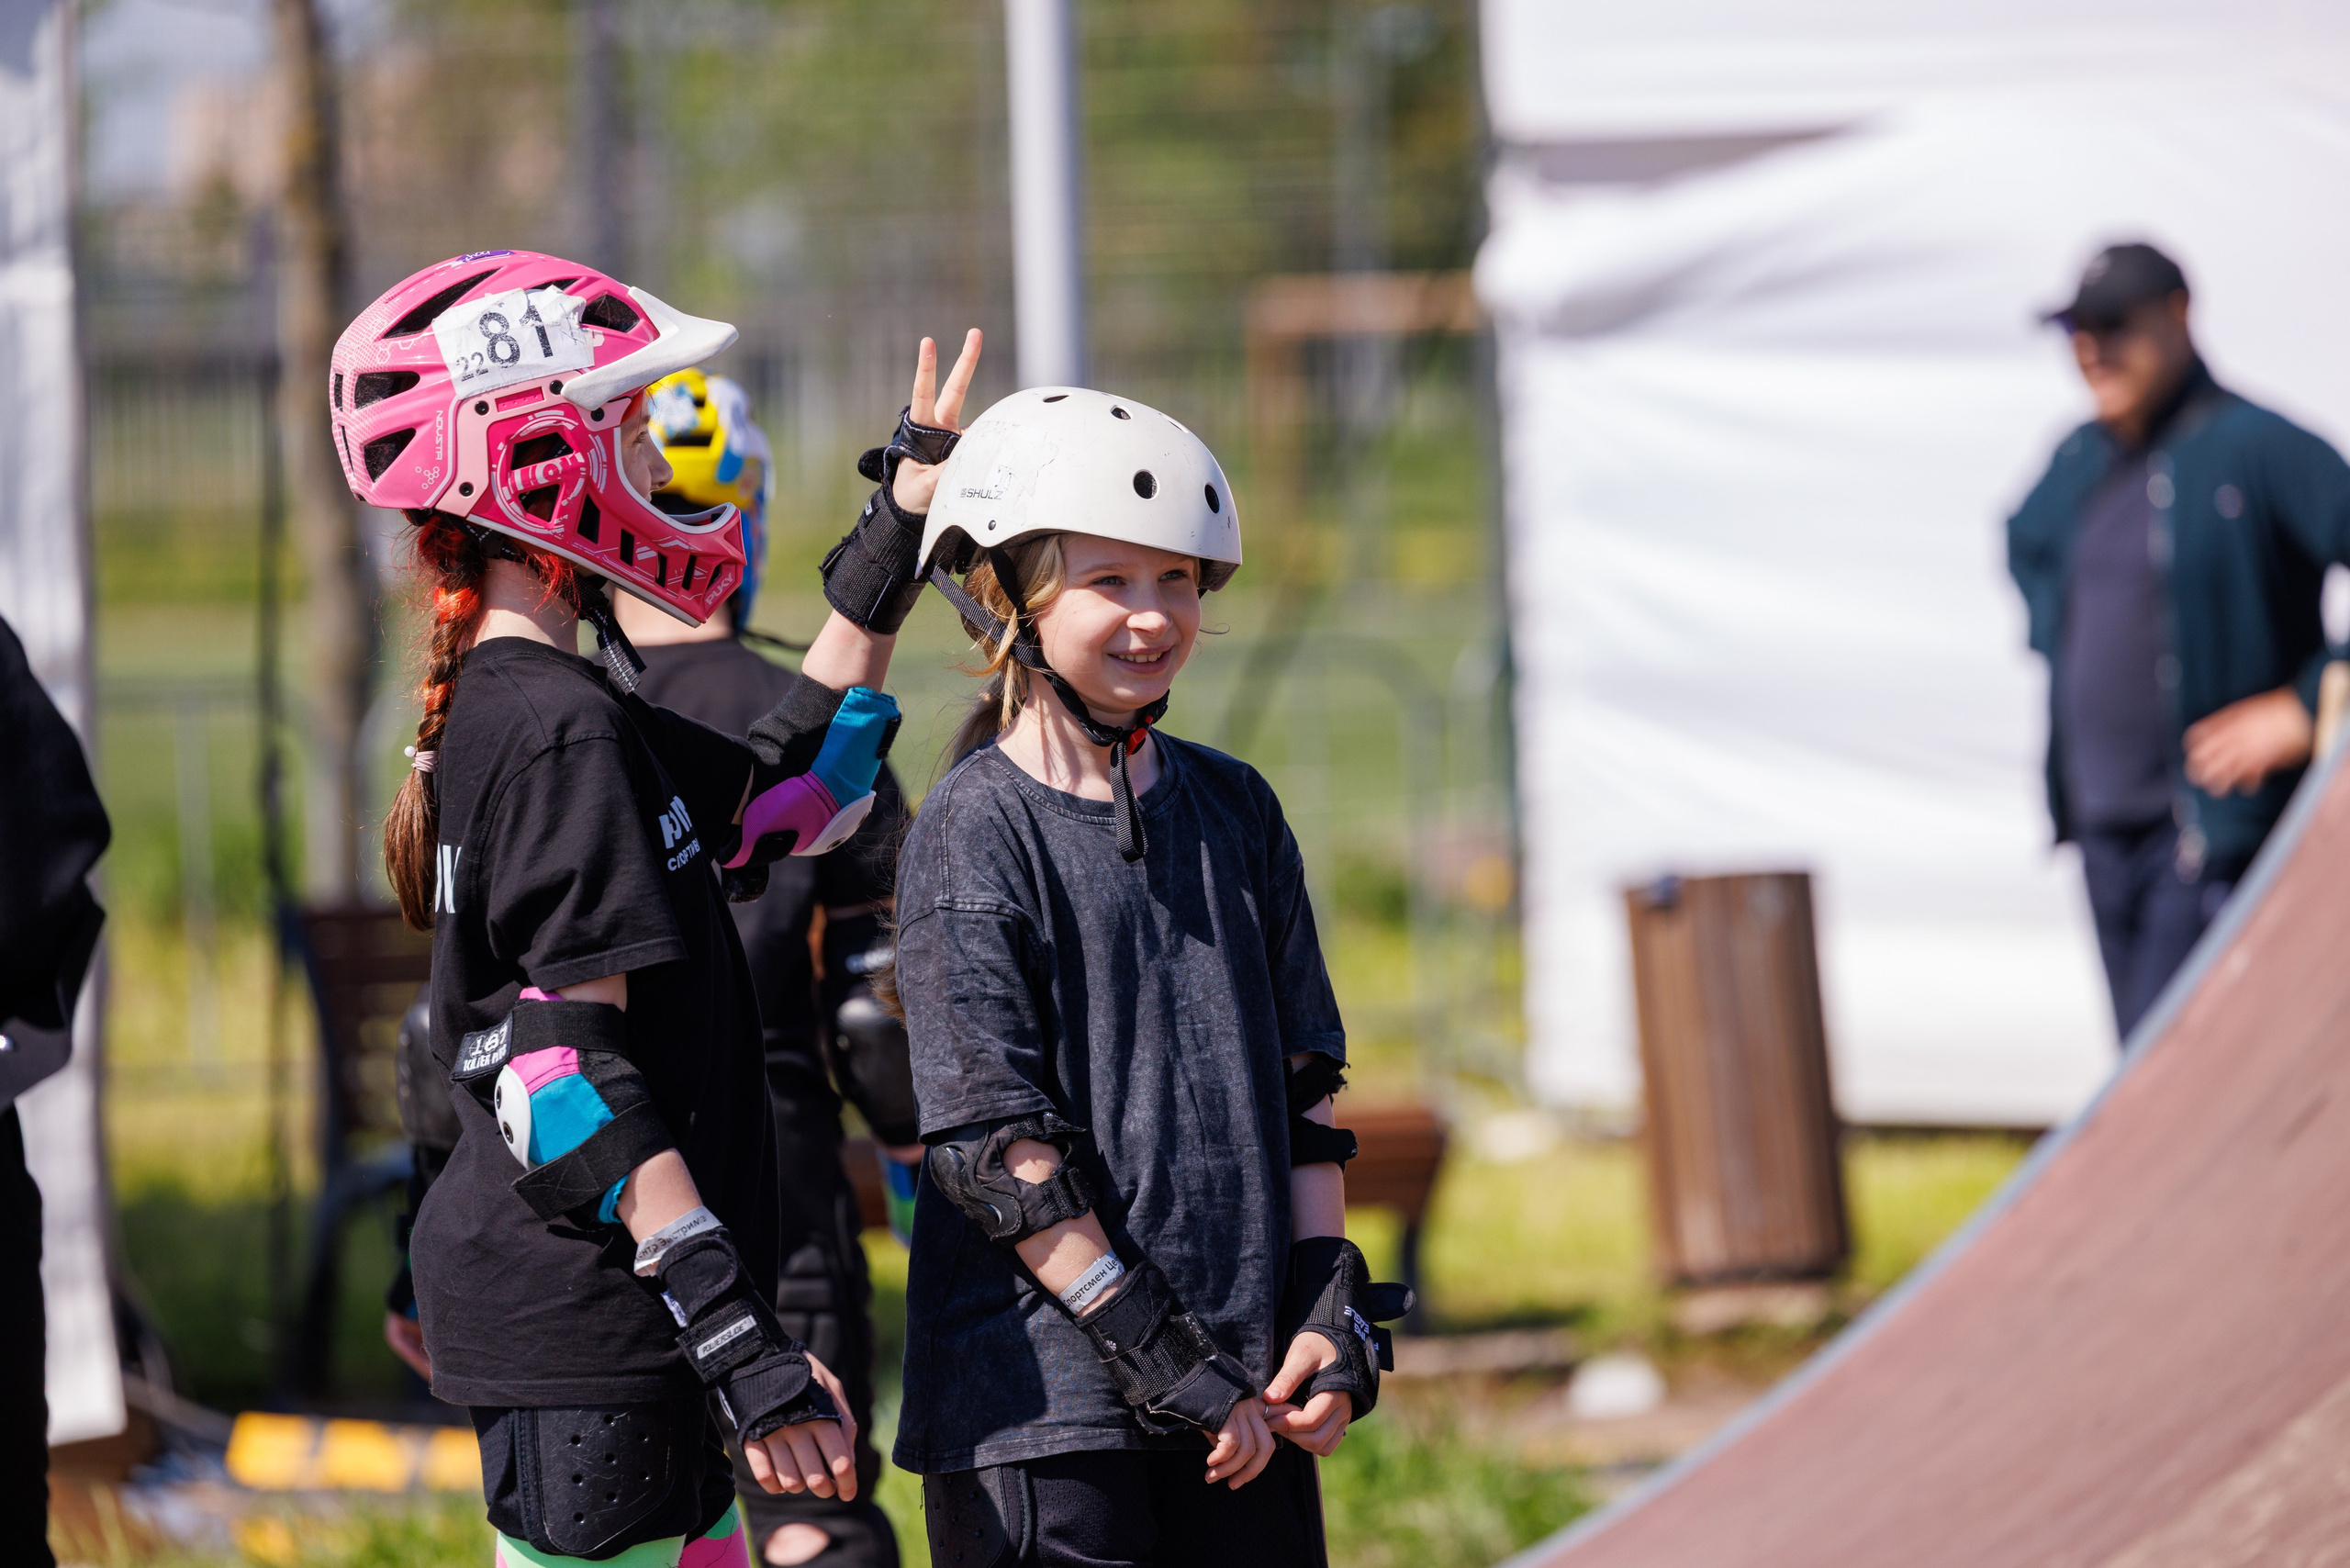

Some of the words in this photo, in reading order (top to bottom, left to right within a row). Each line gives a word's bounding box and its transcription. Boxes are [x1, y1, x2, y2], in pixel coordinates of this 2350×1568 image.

[456, 352, 488, 382] 22
[479, 305, 554, 368] 81
[967, 488, 1003, 500] SHULZ
[705, 572, 733, 606] PUKY
[635, 1244, 659, 1261] ентр
[1343, 1305, 1370, 1335] EAGLE
